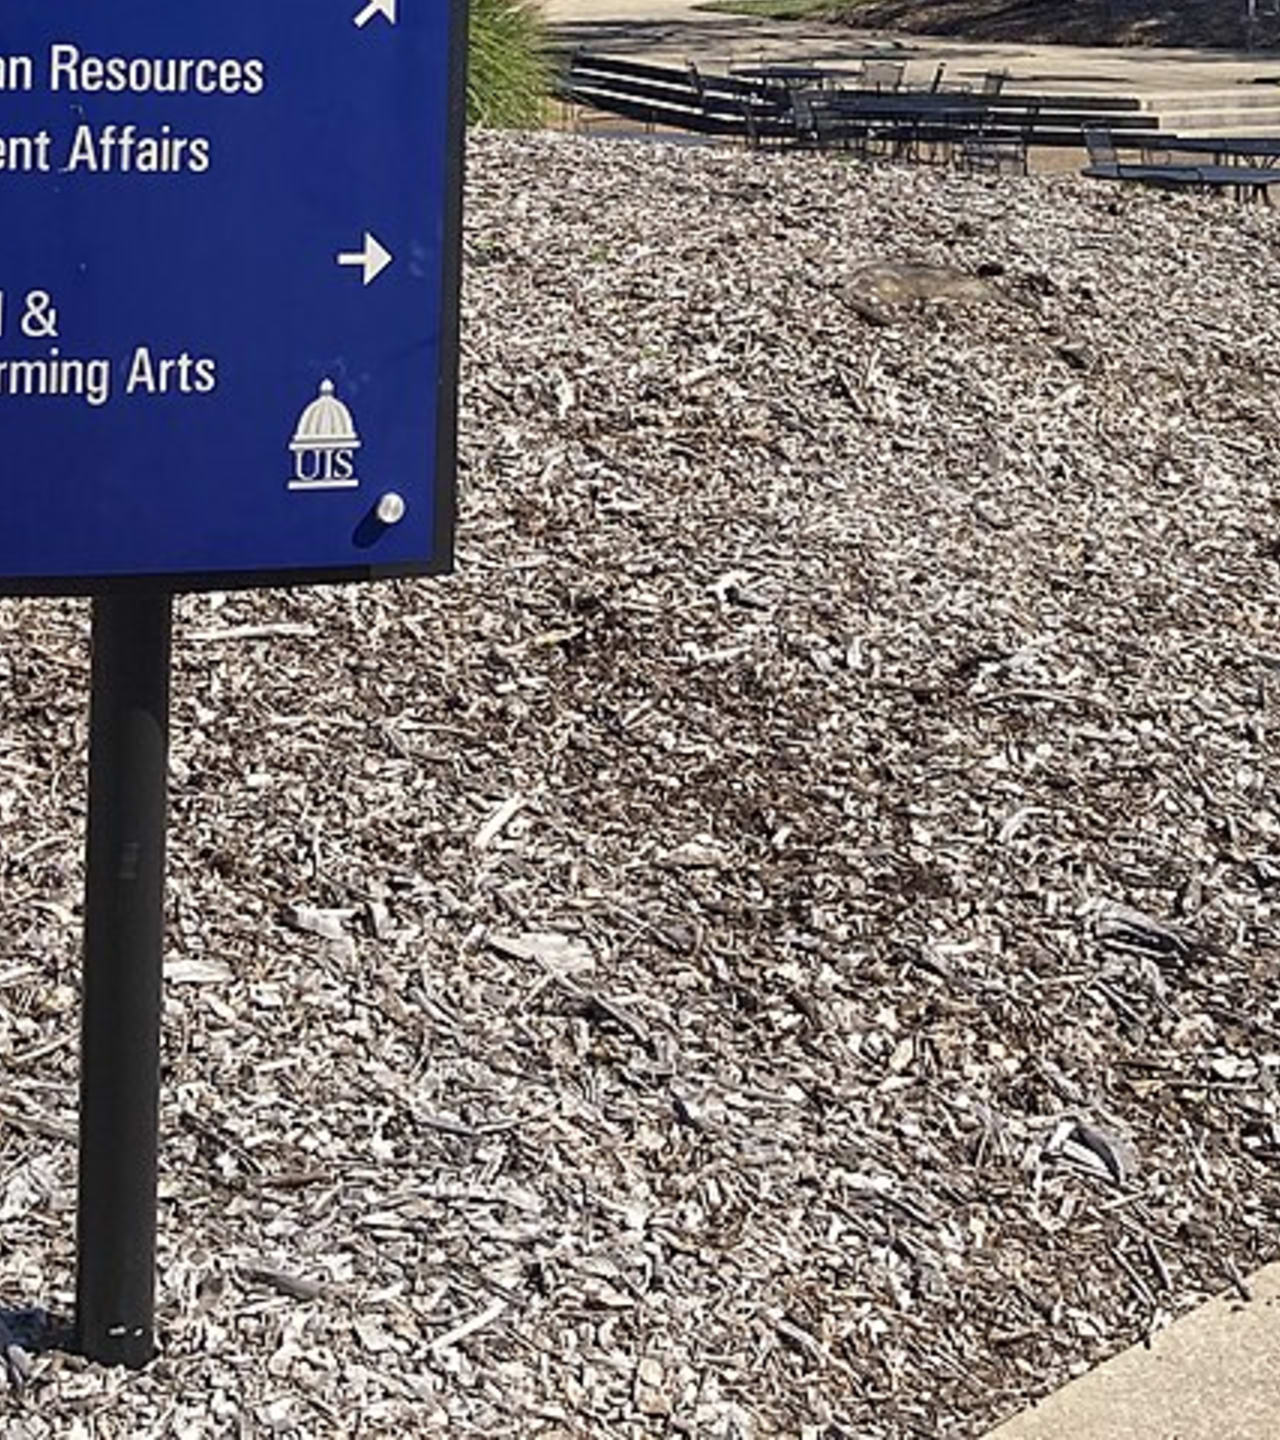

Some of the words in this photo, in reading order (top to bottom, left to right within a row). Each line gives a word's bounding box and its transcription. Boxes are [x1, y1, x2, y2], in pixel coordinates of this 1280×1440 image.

[51, 45, 263, 94] Resources
[69, 125, 209, 172] Affairs
[21, 290, 58, 337] &
[126, 347, 215, 392] Arts
[295, 449, 354, 480] UIS
